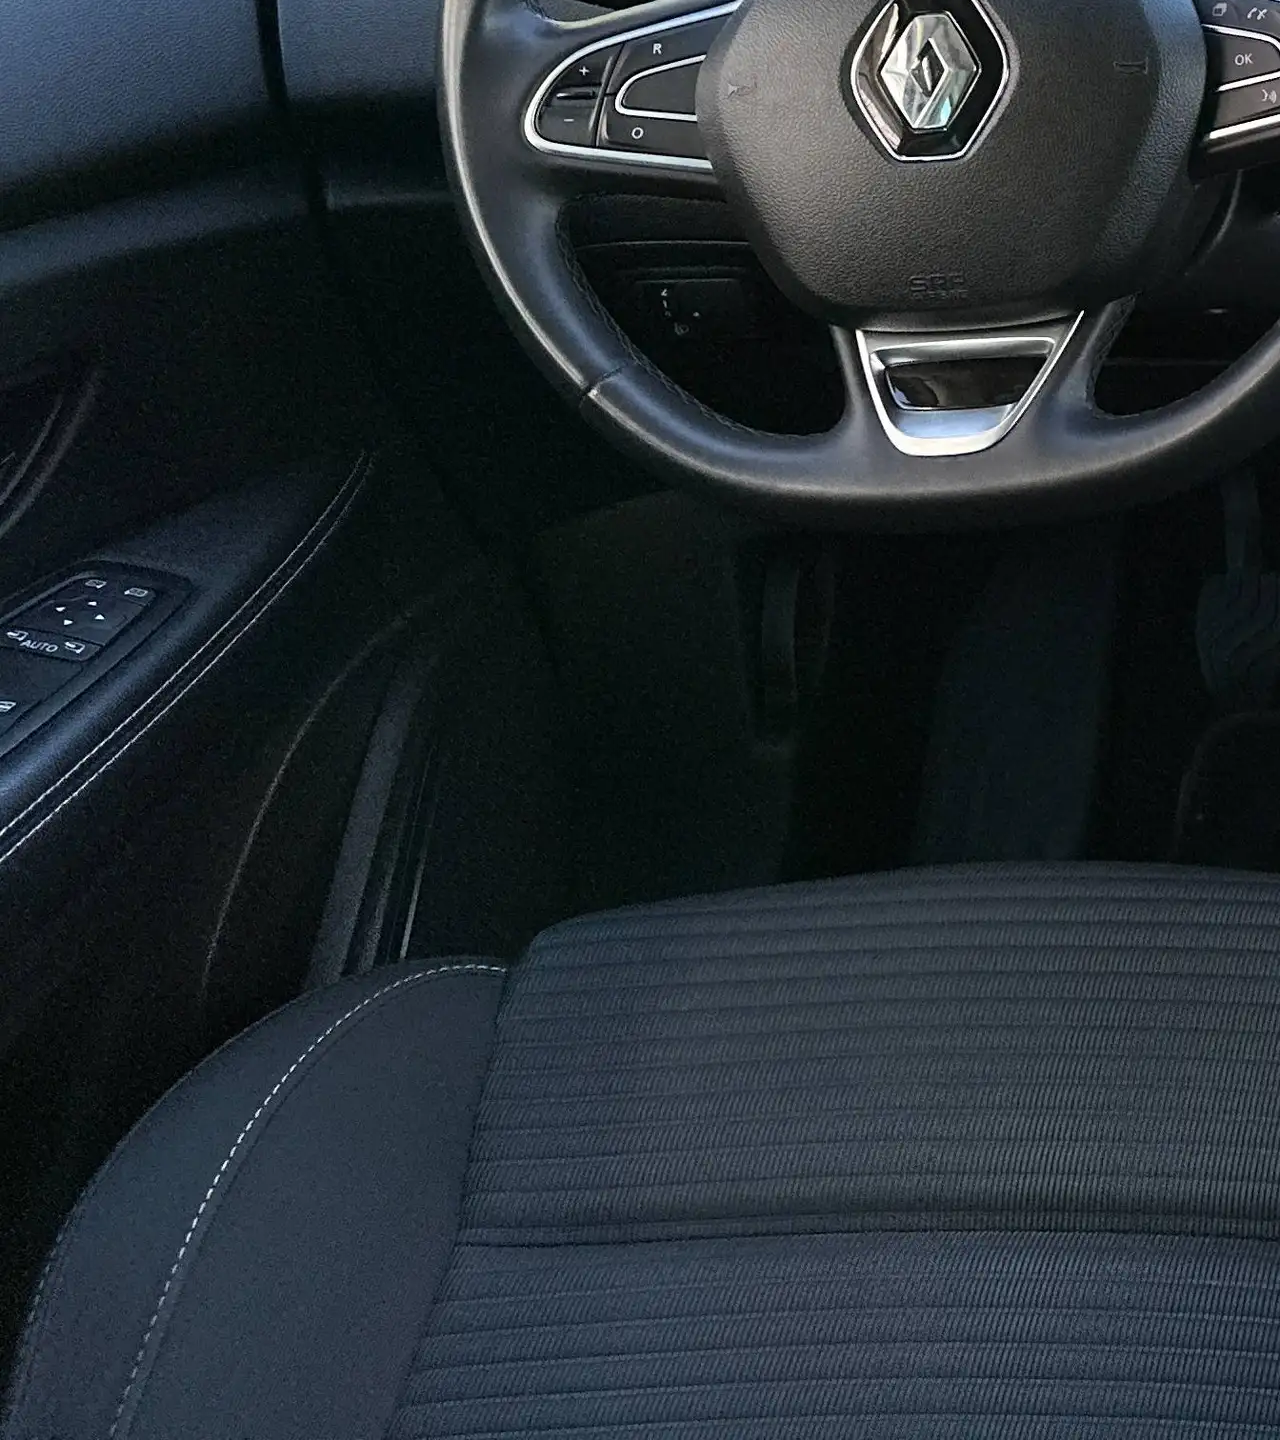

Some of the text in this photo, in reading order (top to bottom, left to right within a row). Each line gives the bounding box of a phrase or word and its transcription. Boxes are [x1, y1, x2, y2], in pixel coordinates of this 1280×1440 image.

[652, 43, 663, 55] R
[1234, 53, 1254, 66] OK
[20, 640, 59, 653] AUTO
